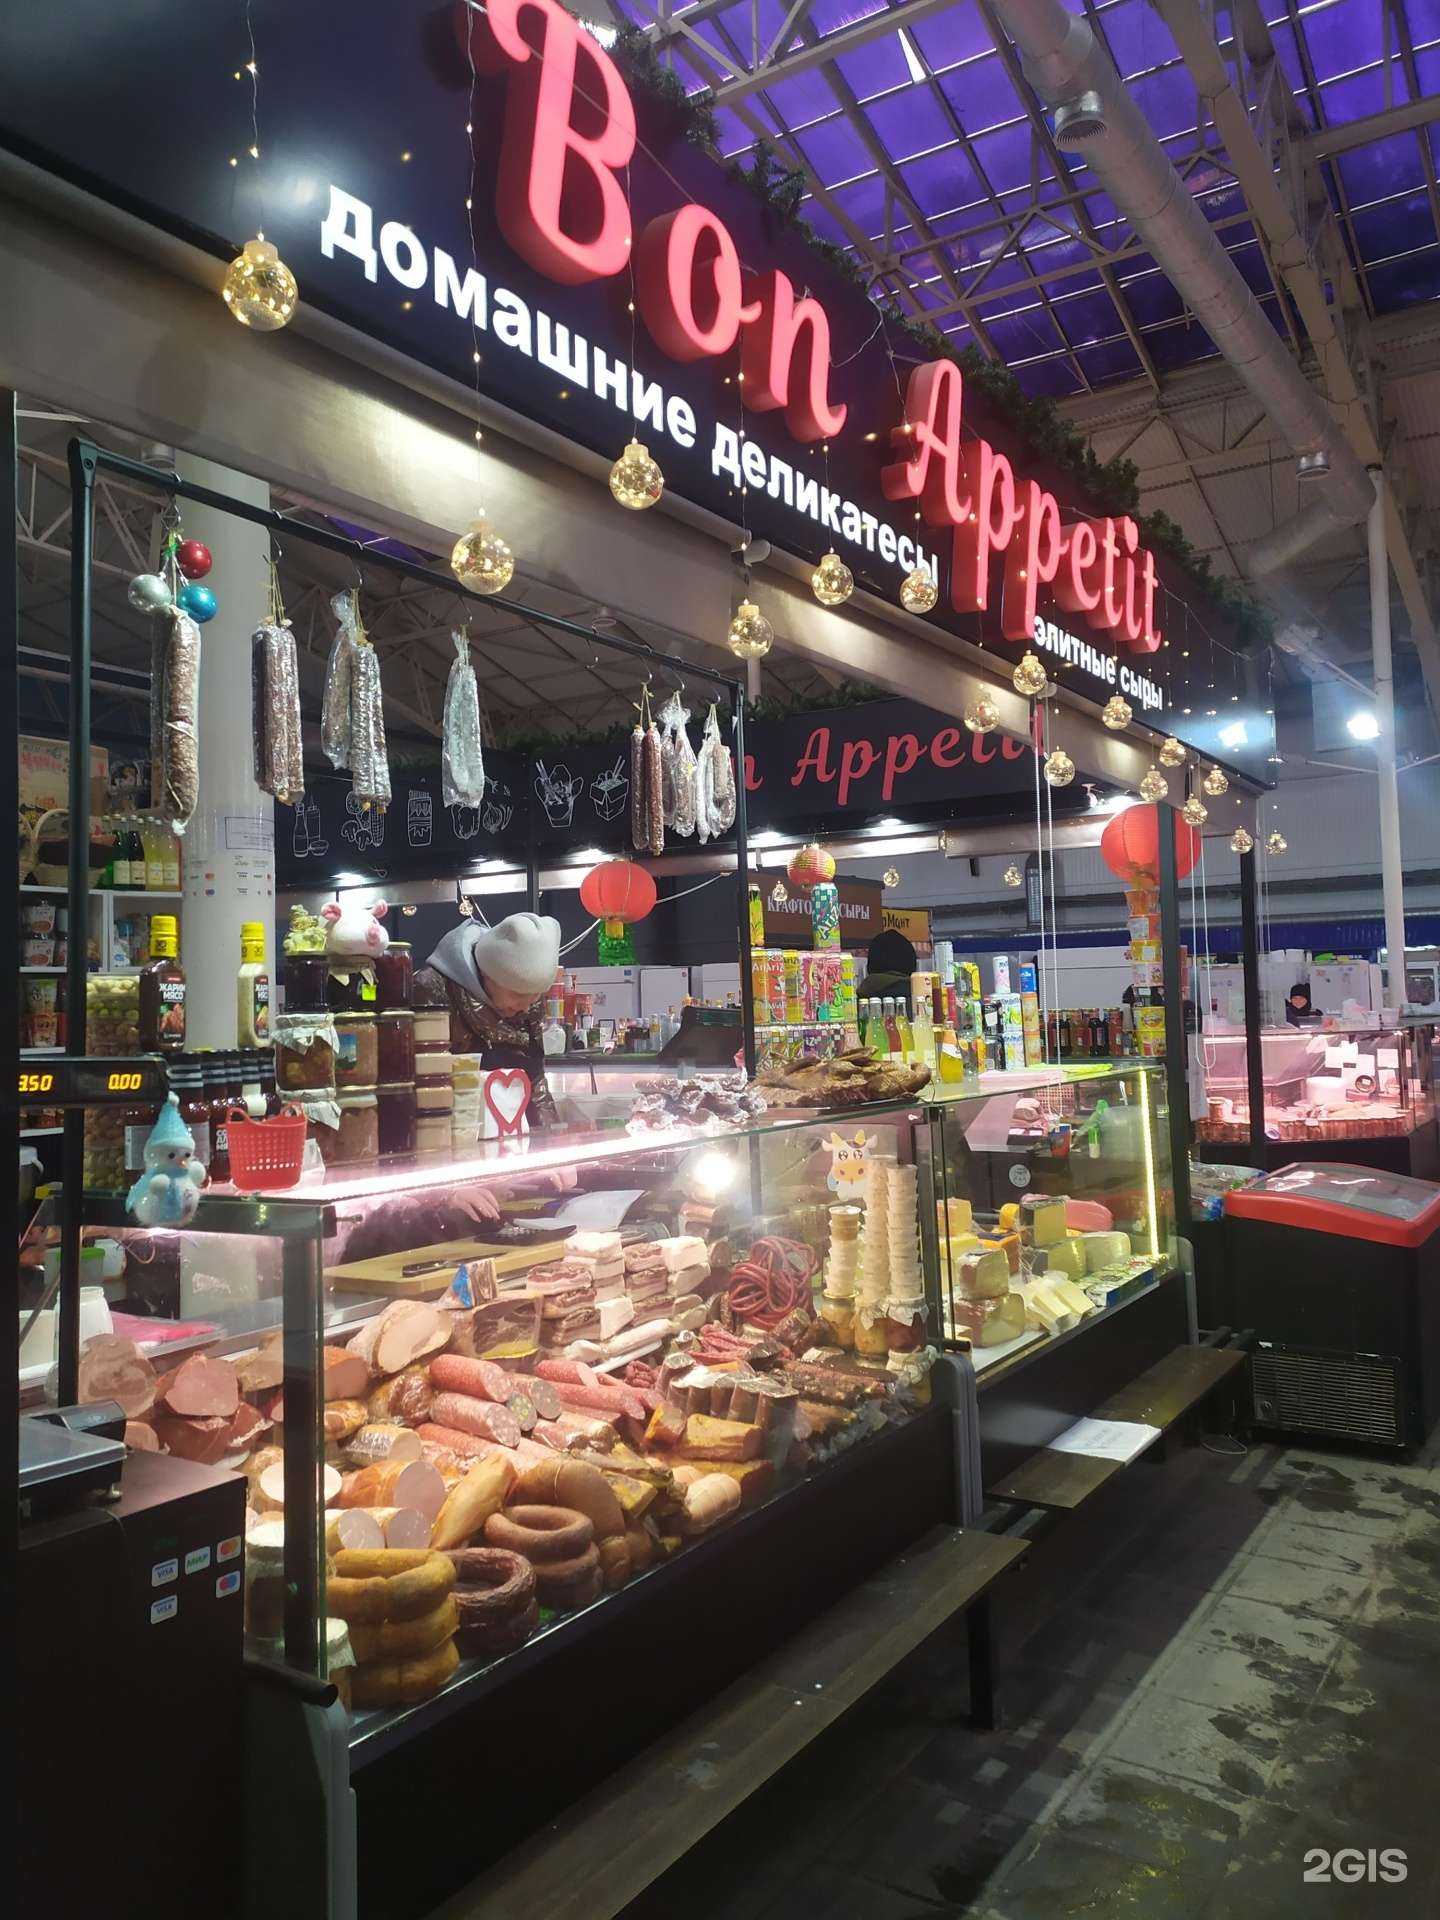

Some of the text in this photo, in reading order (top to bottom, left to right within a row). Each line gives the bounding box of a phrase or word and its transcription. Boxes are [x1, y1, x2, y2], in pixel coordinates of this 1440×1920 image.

[320, 184, 939, 583] домашние деликатесы
[482, 0, 1162, 653] Bon Appetit
[1032, 614, 1164, 711] элитные сыры
